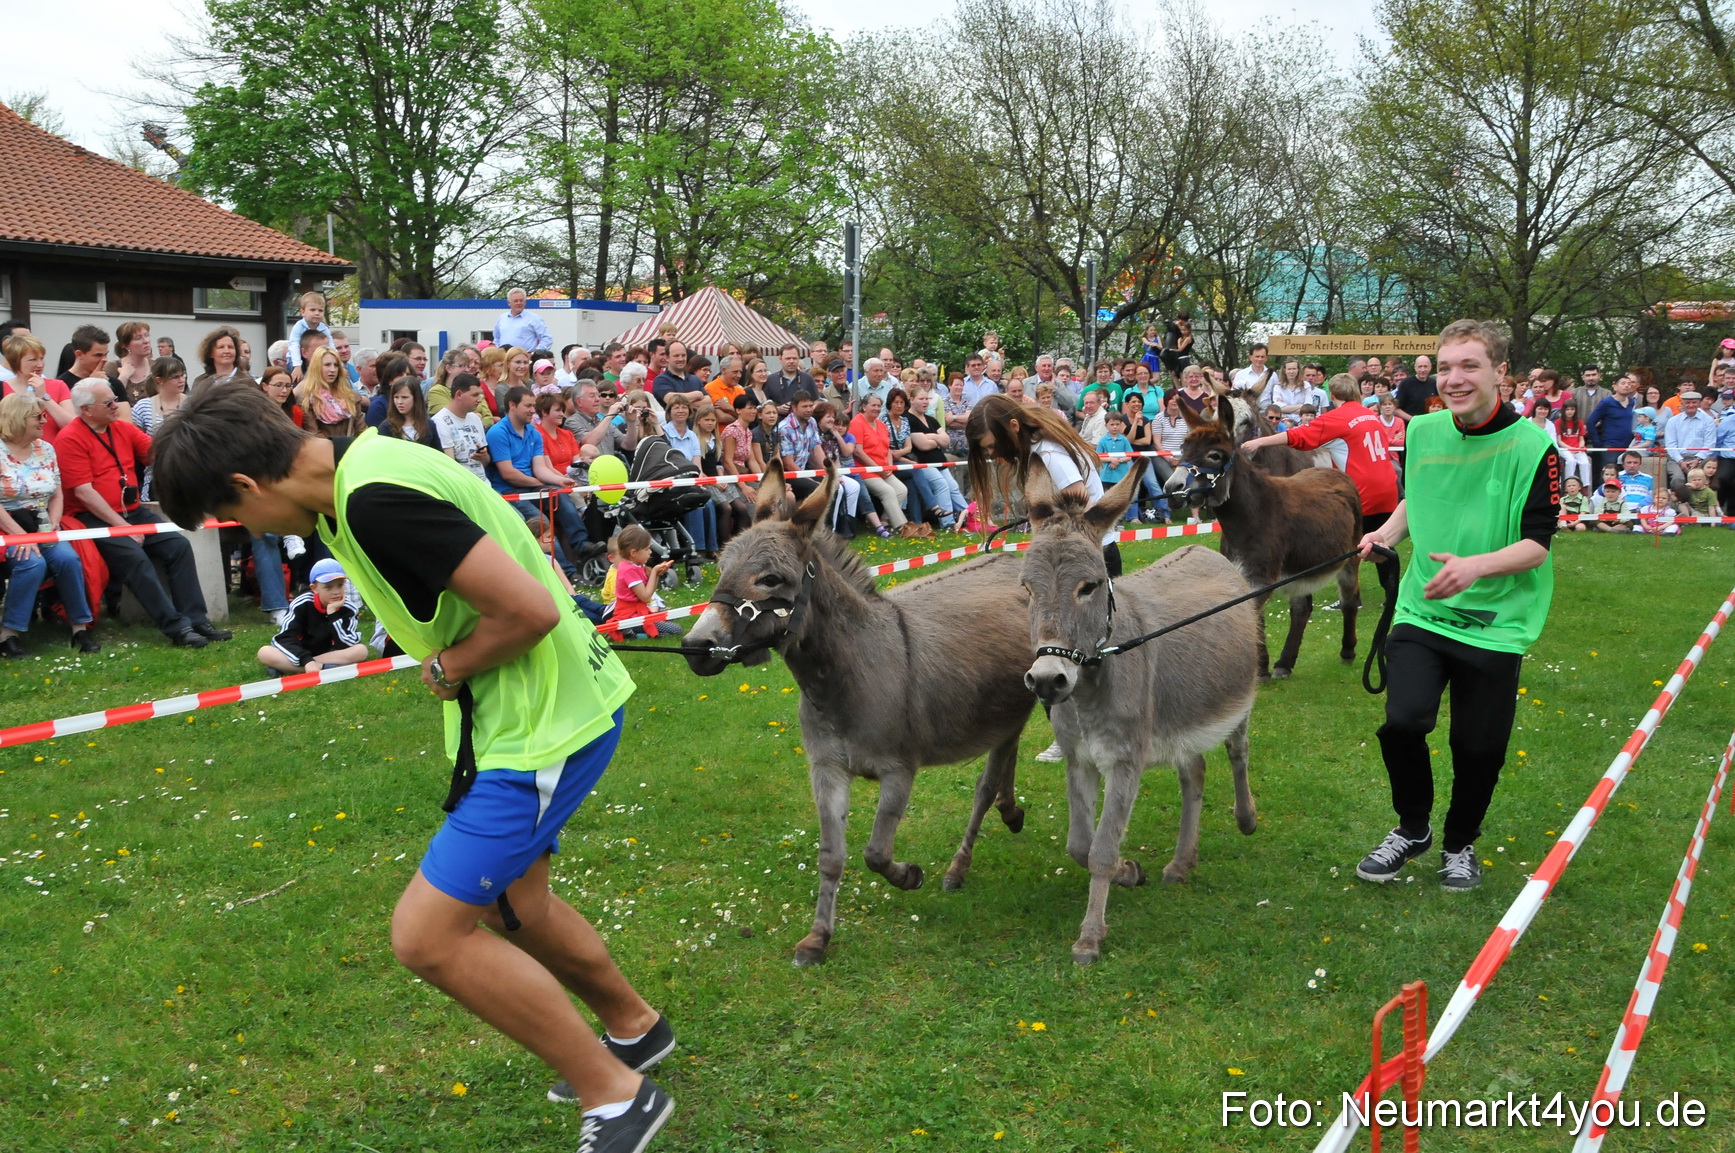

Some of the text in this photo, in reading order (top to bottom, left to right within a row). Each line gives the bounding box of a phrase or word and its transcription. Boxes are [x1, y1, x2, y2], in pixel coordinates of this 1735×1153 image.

[1284, 338, 1357, 353] Pony-Reitstall
[1362, 339, 1385, 351] Berr
[1363, 430, 1386, 463] 14
